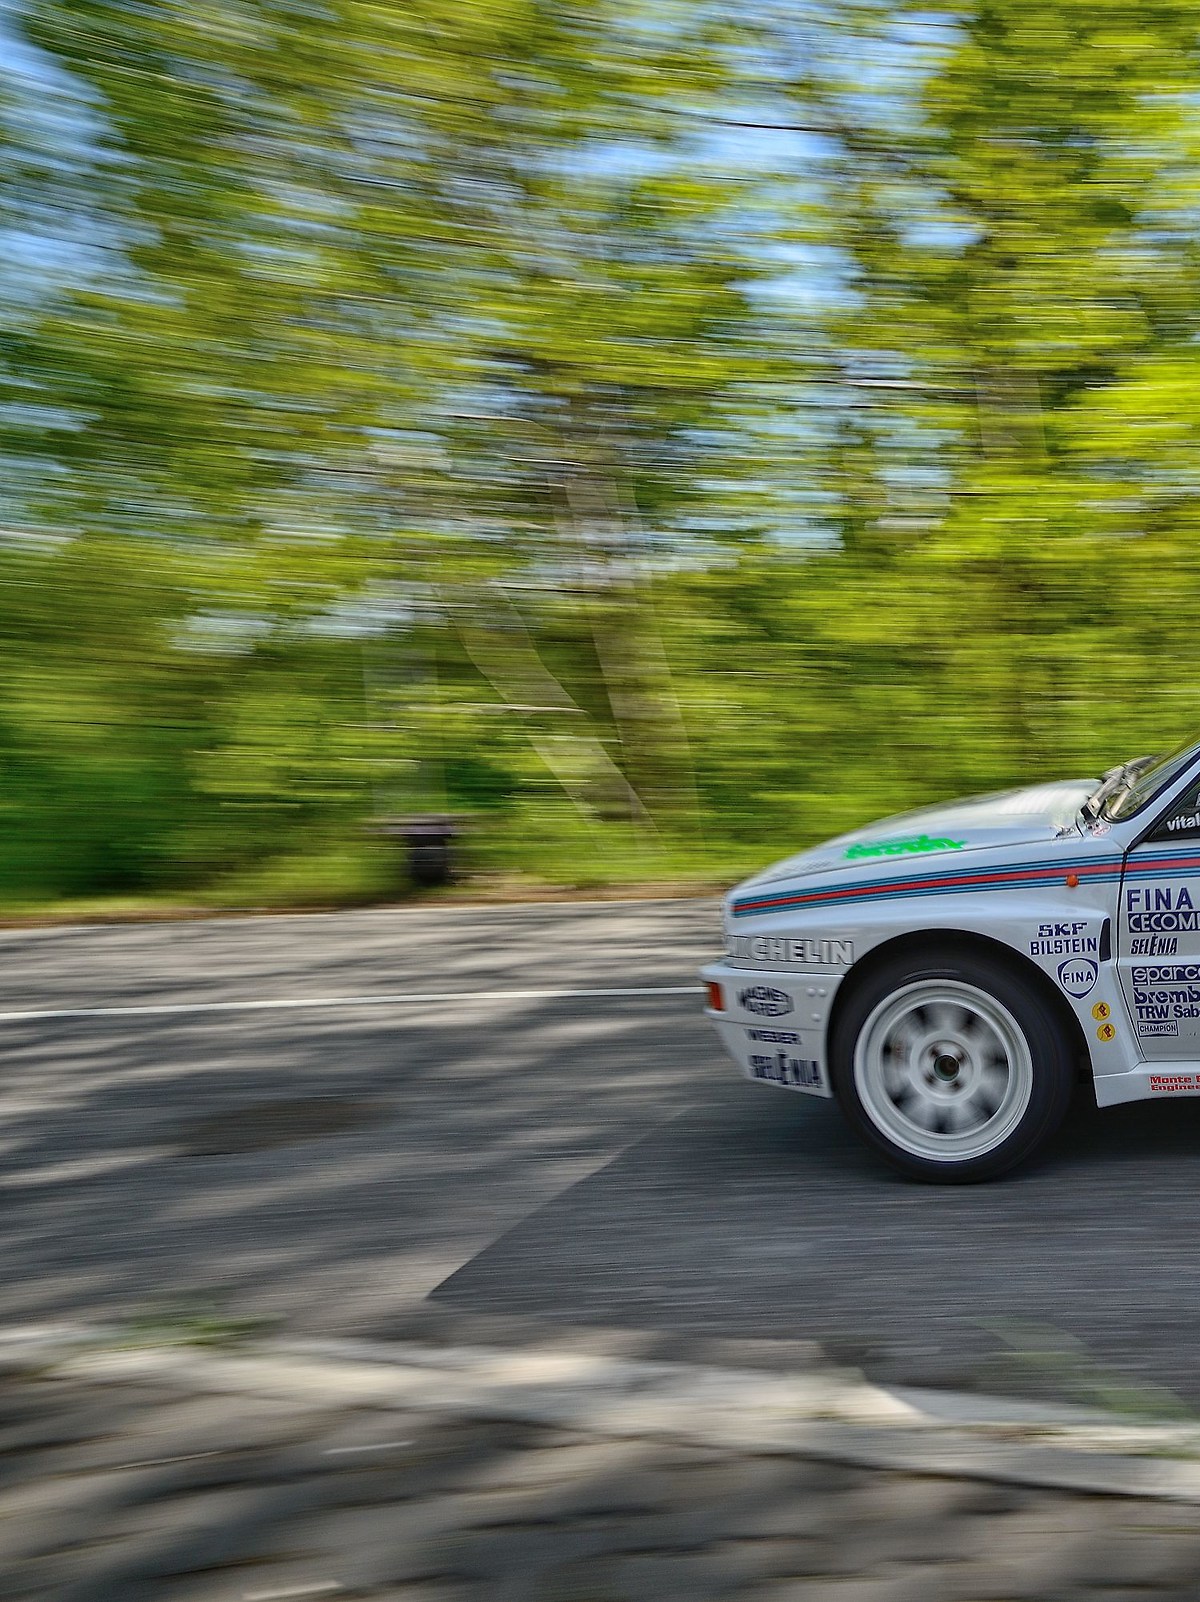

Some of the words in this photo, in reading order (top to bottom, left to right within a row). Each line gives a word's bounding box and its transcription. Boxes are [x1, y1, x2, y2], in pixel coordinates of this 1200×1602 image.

[1127, 888, 1194, 911] FINA
[1038, 922, 1088, 937] SKF
[1030, 937, 1097, 955] BILSTEIN
[1062, 971, 1094, 983] FINA
[1136, 1005, 1170, 1019] TRW
[1139, 1023, 1176, 1033] CHAMPION
